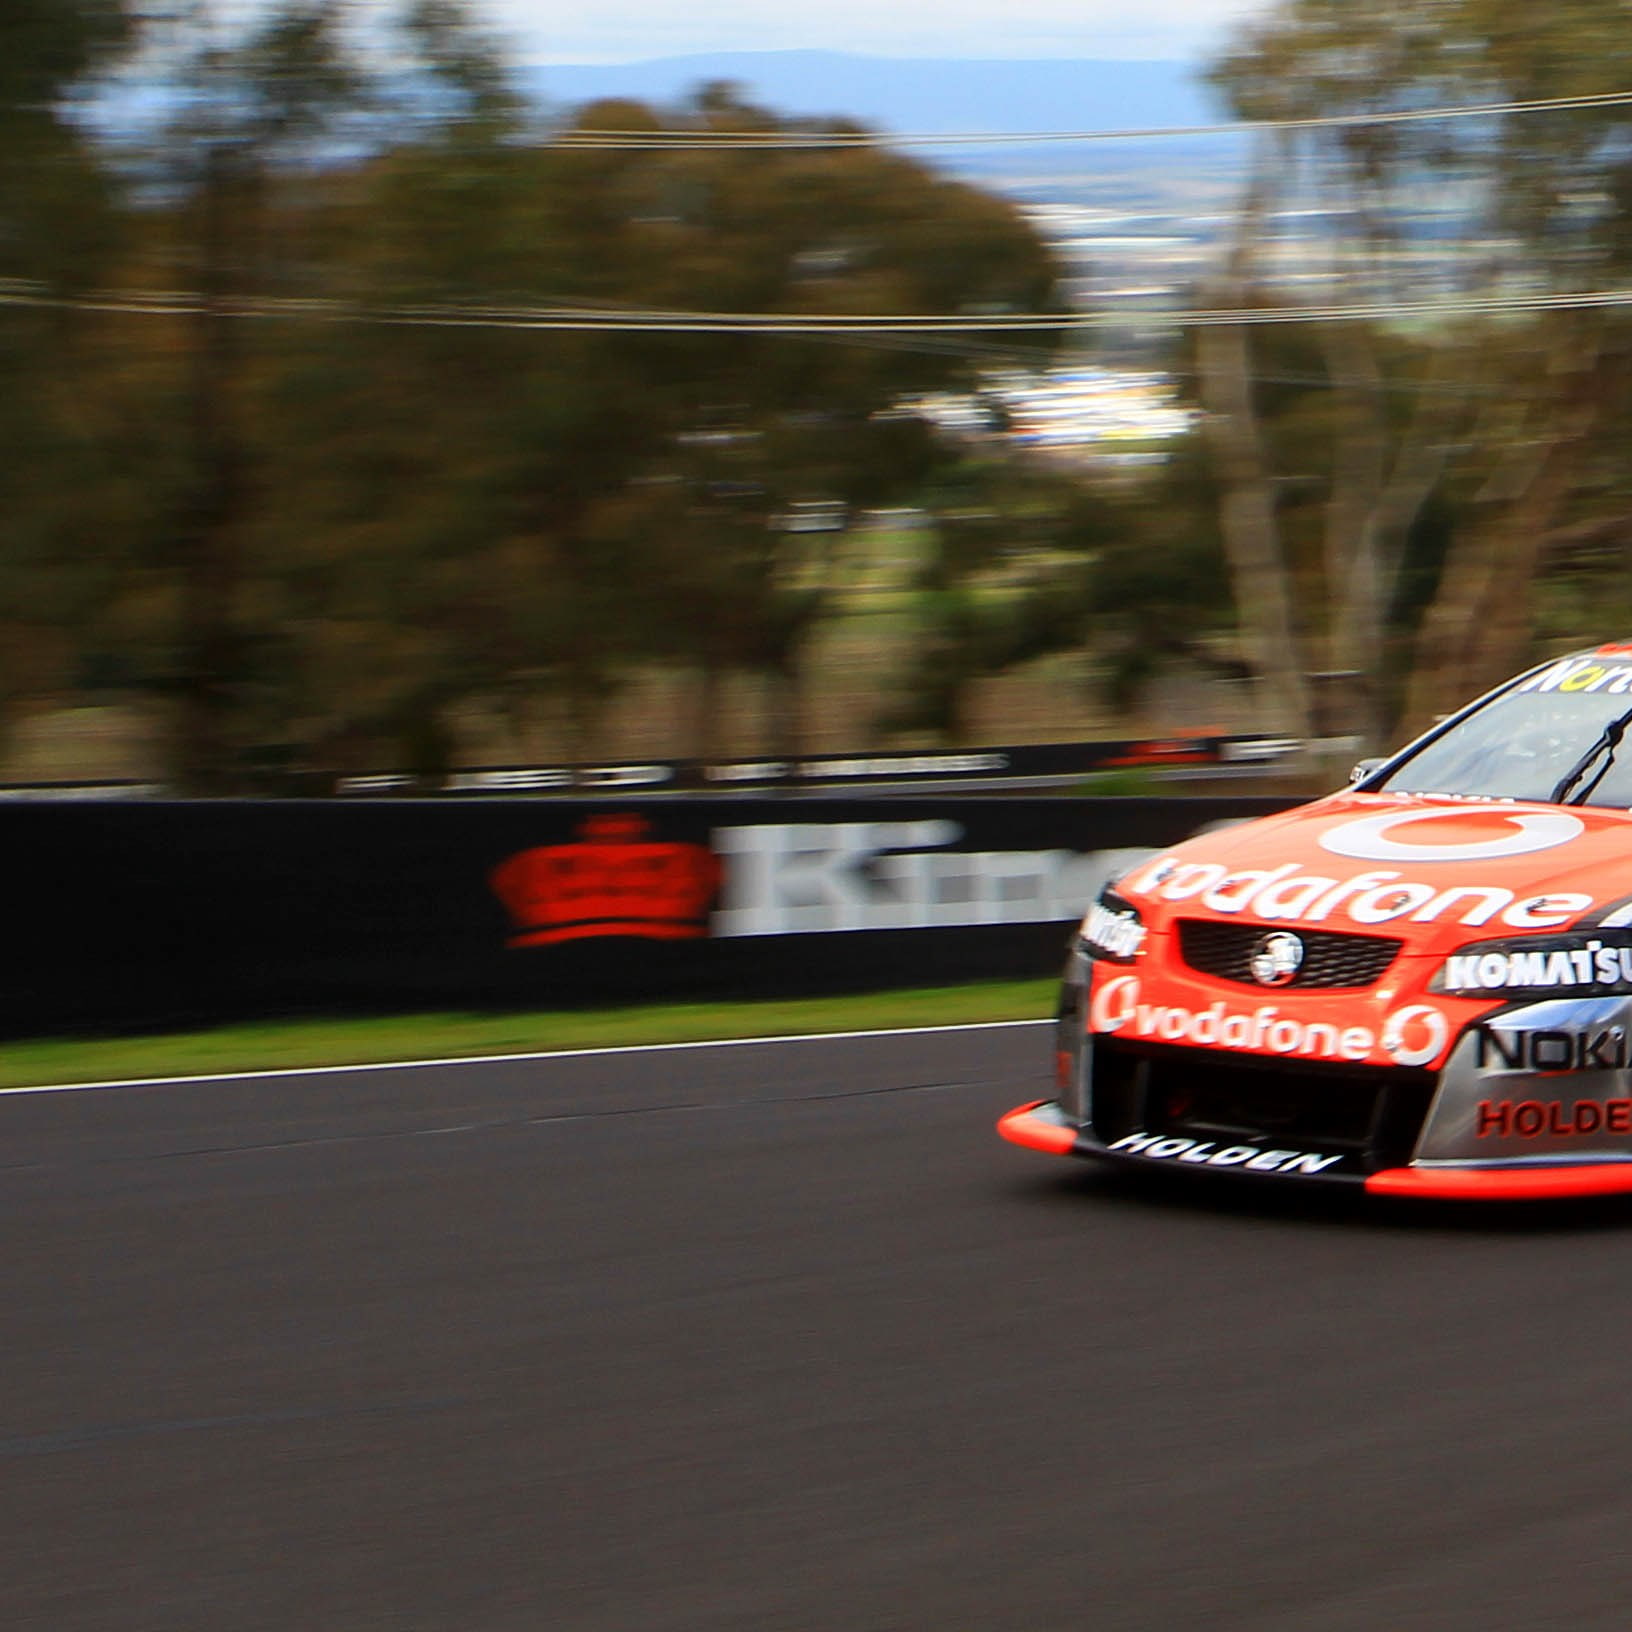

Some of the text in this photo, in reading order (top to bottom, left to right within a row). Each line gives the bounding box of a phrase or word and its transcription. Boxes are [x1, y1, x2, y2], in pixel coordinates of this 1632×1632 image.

[1132, 857, 1594, 928] vodafone
[1135, 1001, 1374, 1061] vodafone
[1106, 1131, 1344, 1174] HOLDEN
